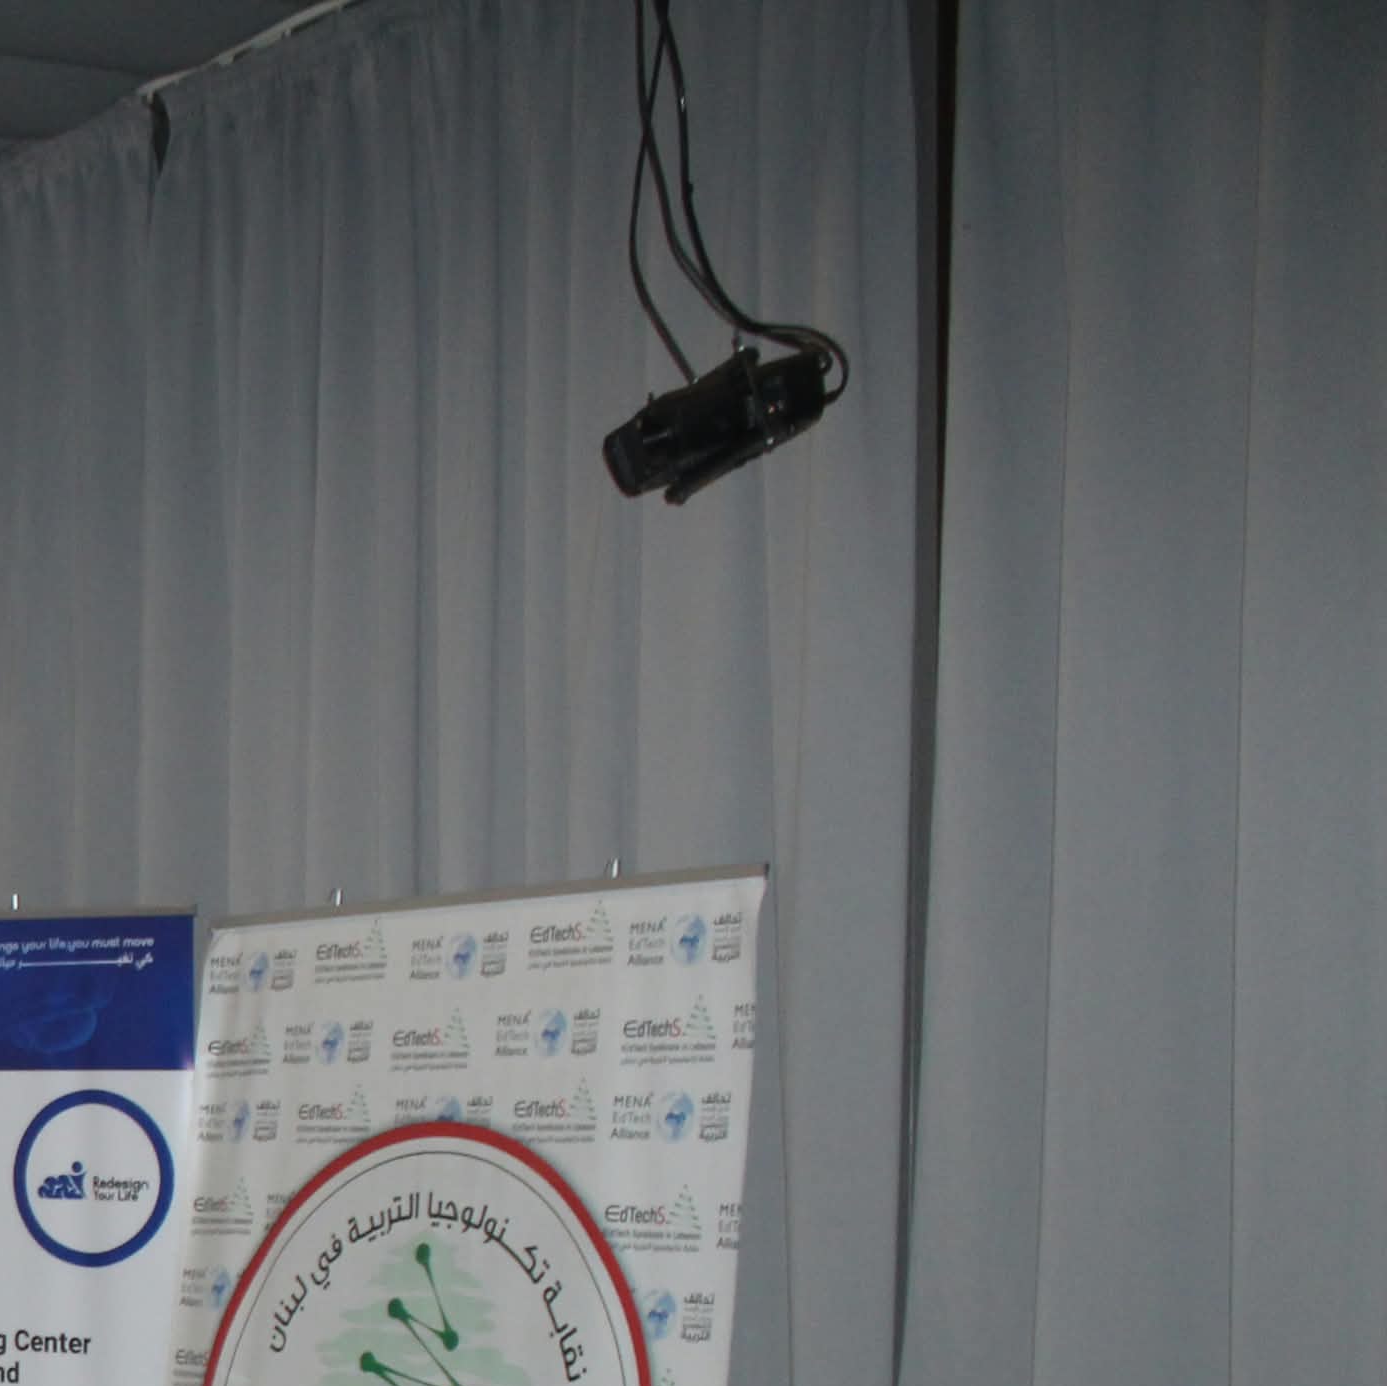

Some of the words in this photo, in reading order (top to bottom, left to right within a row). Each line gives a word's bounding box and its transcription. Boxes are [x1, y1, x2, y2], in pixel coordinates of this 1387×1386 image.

[93, 1175, 149, 1193] Redesign
[348, 1192, 420, 1242] التربية
[605, 1205, 667, 1226] EdTechS
[311, 1234, 344, 1290] في
[270, 1275, 308, 1353] لبنان
[14, 1329, 91, 1354] Center
